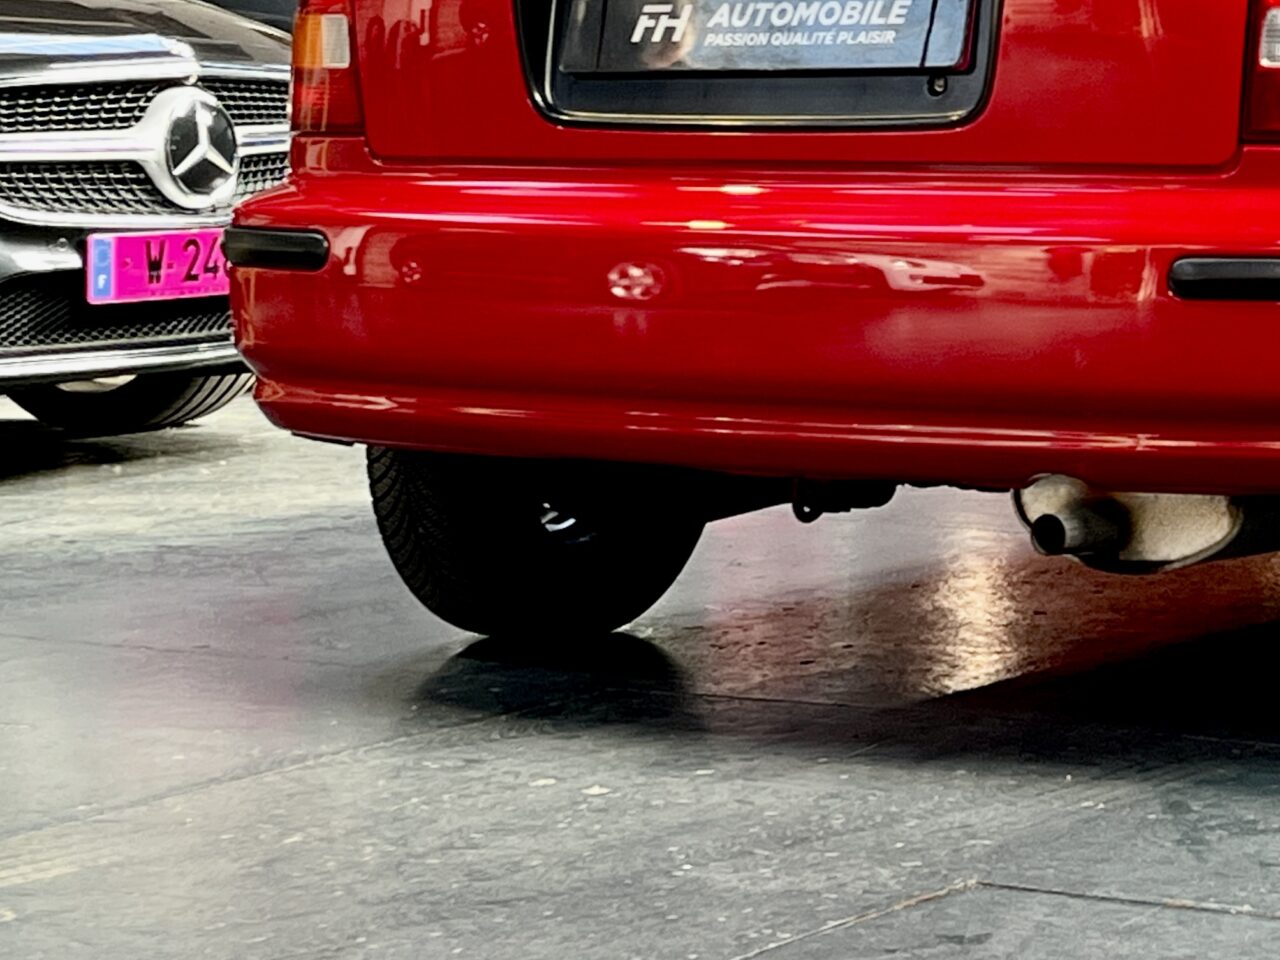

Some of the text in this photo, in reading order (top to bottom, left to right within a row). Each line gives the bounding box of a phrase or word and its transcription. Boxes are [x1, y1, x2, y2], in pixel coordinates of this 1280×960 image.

[630, 4, 693, 44] FH
[706, 0, 913, 29] AUTOMOBILE
[703, 28, 897, 47] PASSION QUALITÉ PLAISIR
